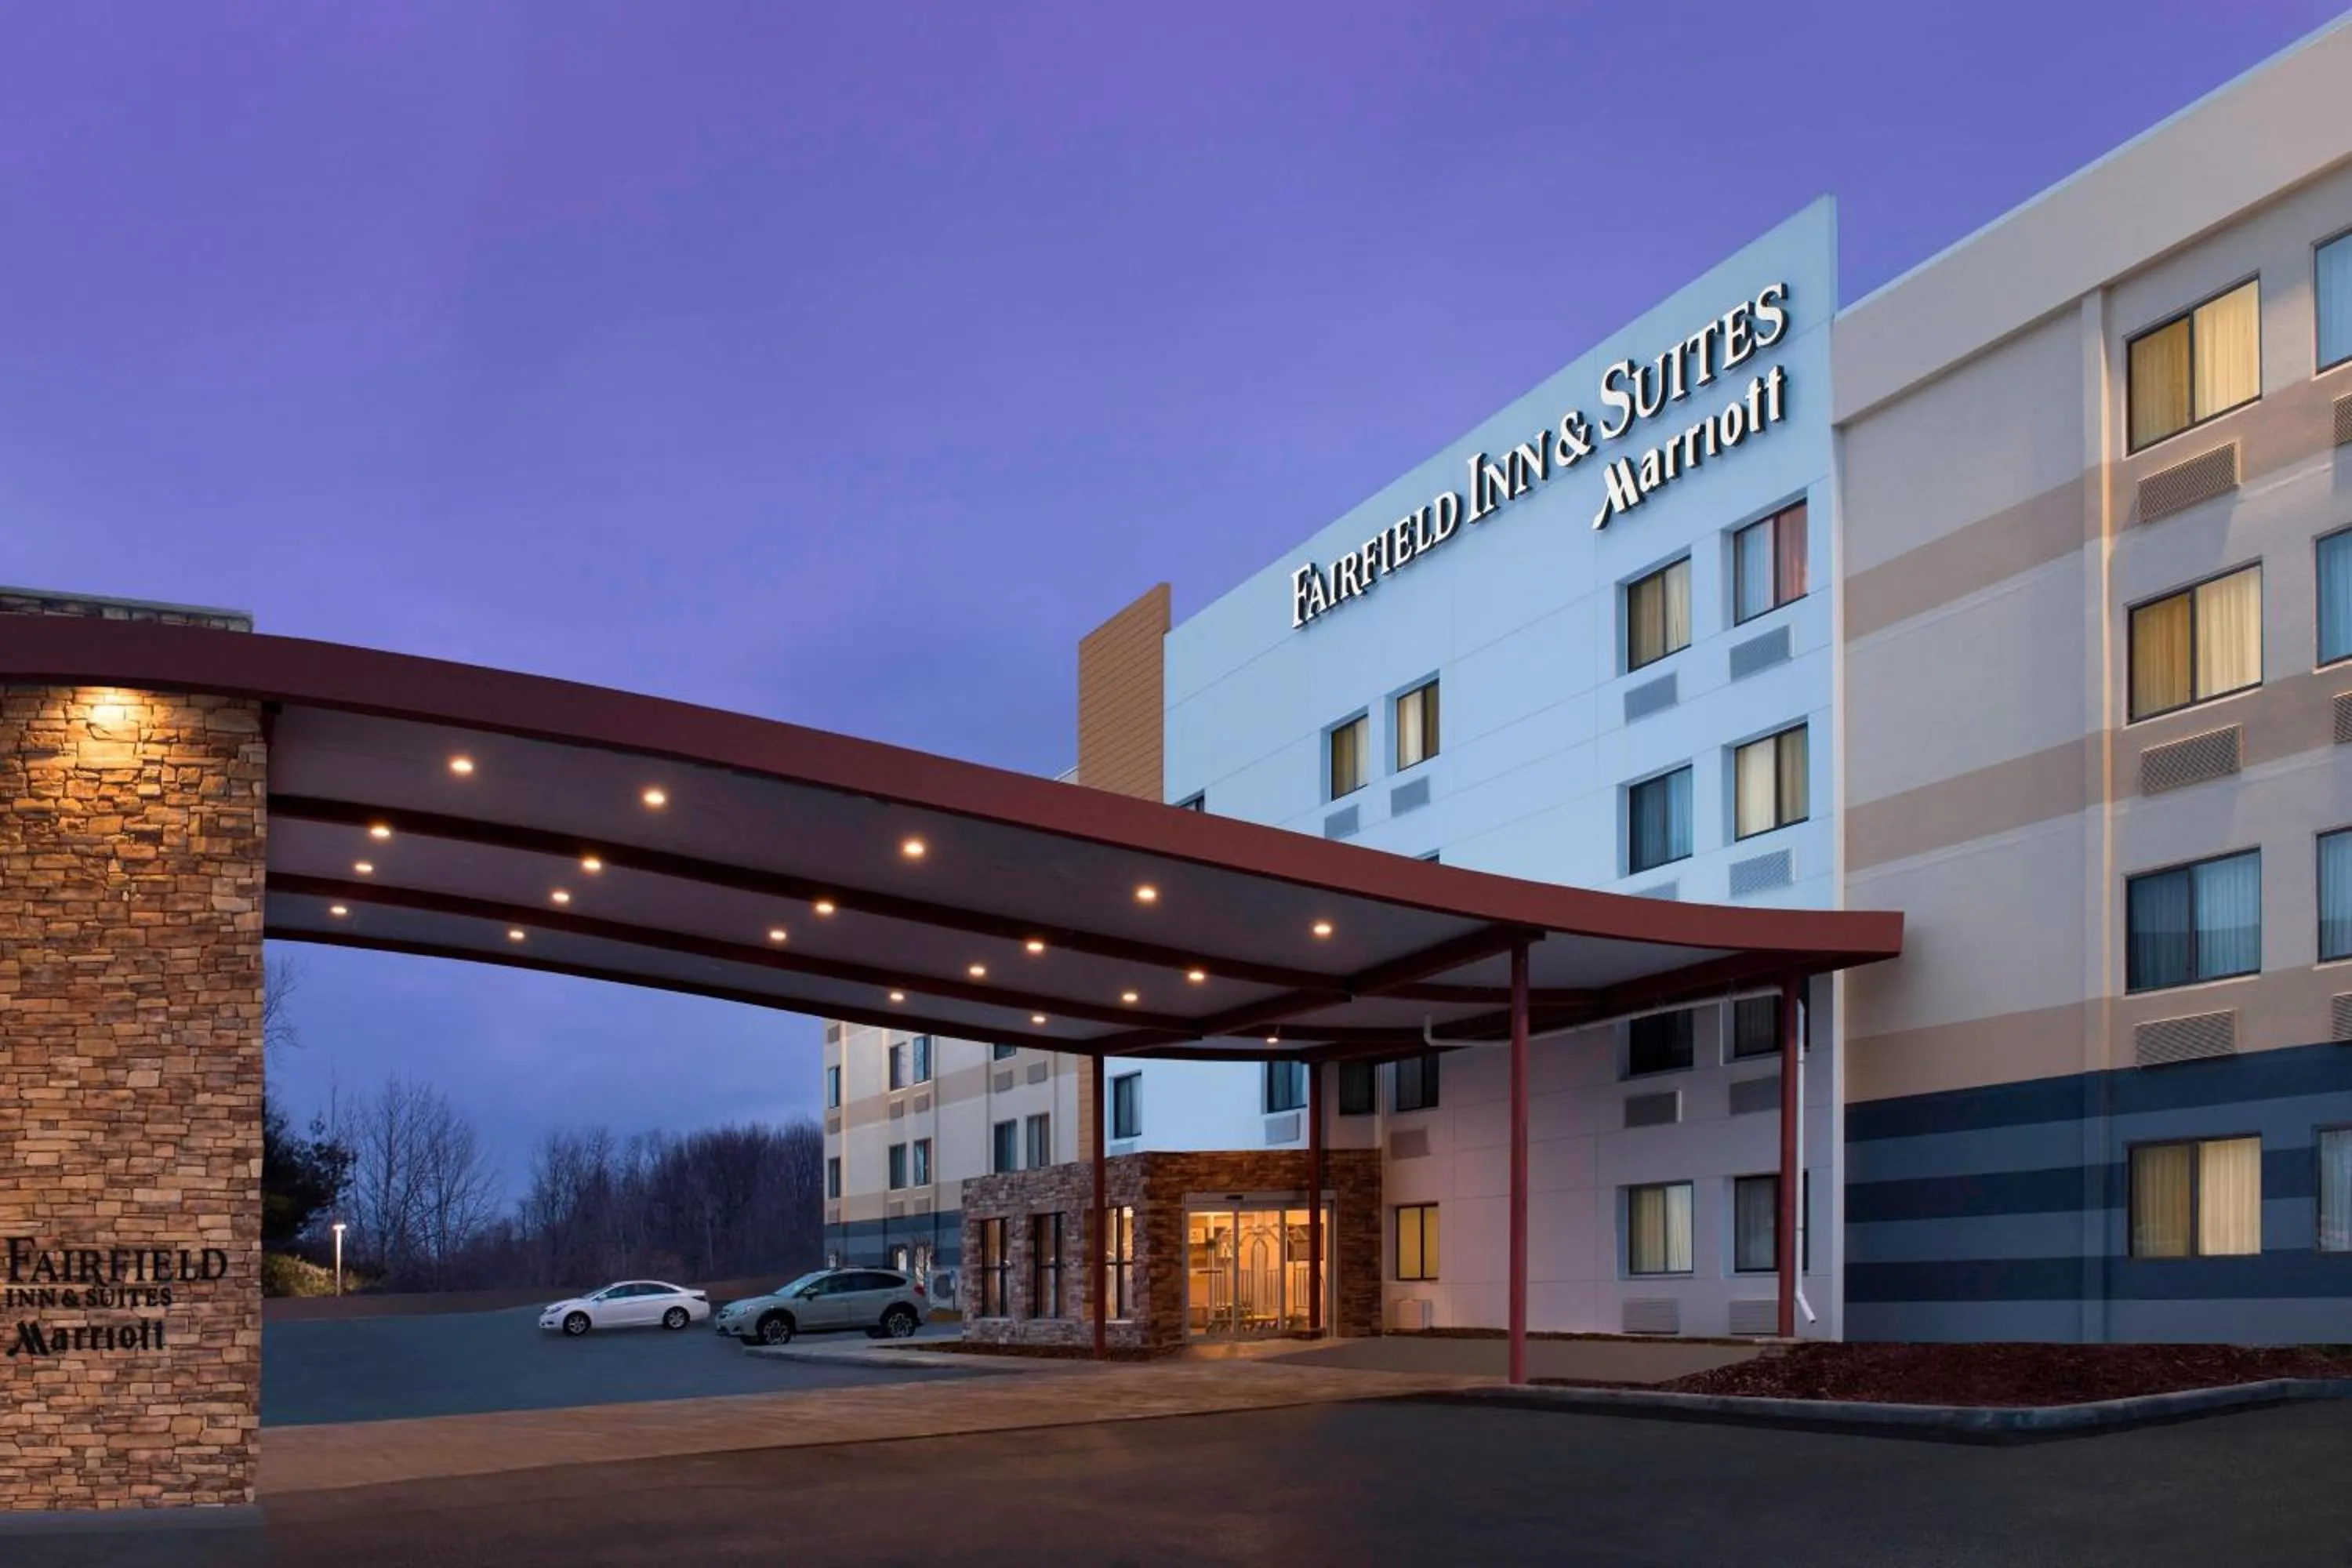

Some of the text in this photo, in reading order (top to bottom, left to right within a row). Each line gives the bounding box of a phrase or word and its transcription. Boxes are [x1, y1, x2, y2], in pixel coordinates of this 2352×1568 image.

[1291, 282, 1788, 628] FAIRFIELD INN & SUITES
[1593, 365, 1785, 531] Marriott
[5, 1237, 227, 1287] FAIRFIELD
[6, 1287, 172, 1308] INN & SUITES
[6, 1318, 165, 1356] Marriott
